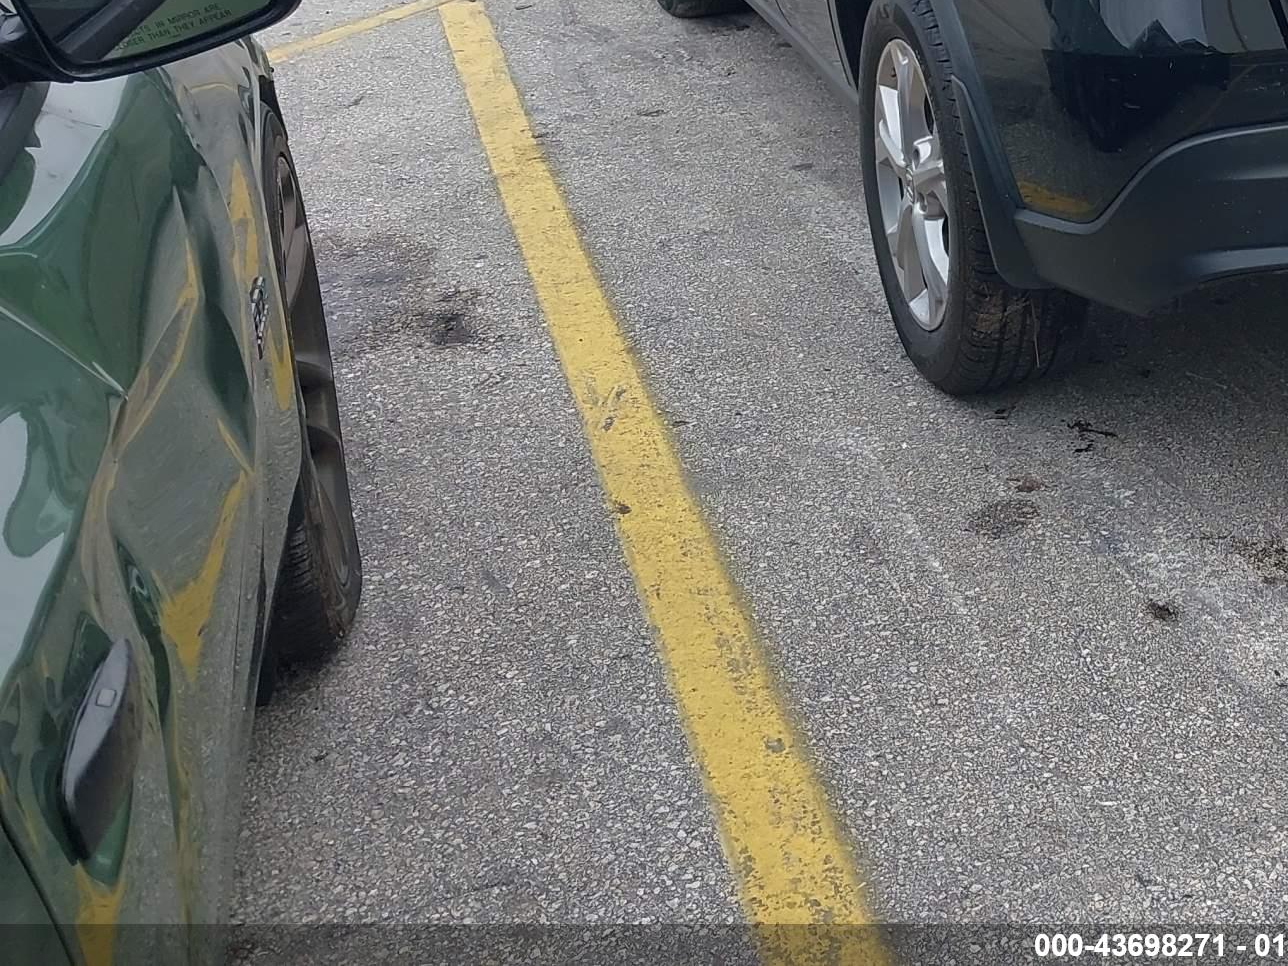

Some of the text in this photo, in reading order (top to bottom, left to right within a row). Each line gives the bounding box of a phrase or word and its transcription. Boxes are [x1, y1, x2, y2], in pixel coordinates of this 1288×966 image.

[148, 30, 171, 42] THAN
[174, 21, 195, 34] THEY
[199, 9, 233, 25] APPEAR
[154, 20, 165, 30] IN
[167, 9, 201, 25] MIRROR
[204, 2, 222, 13] ARE
